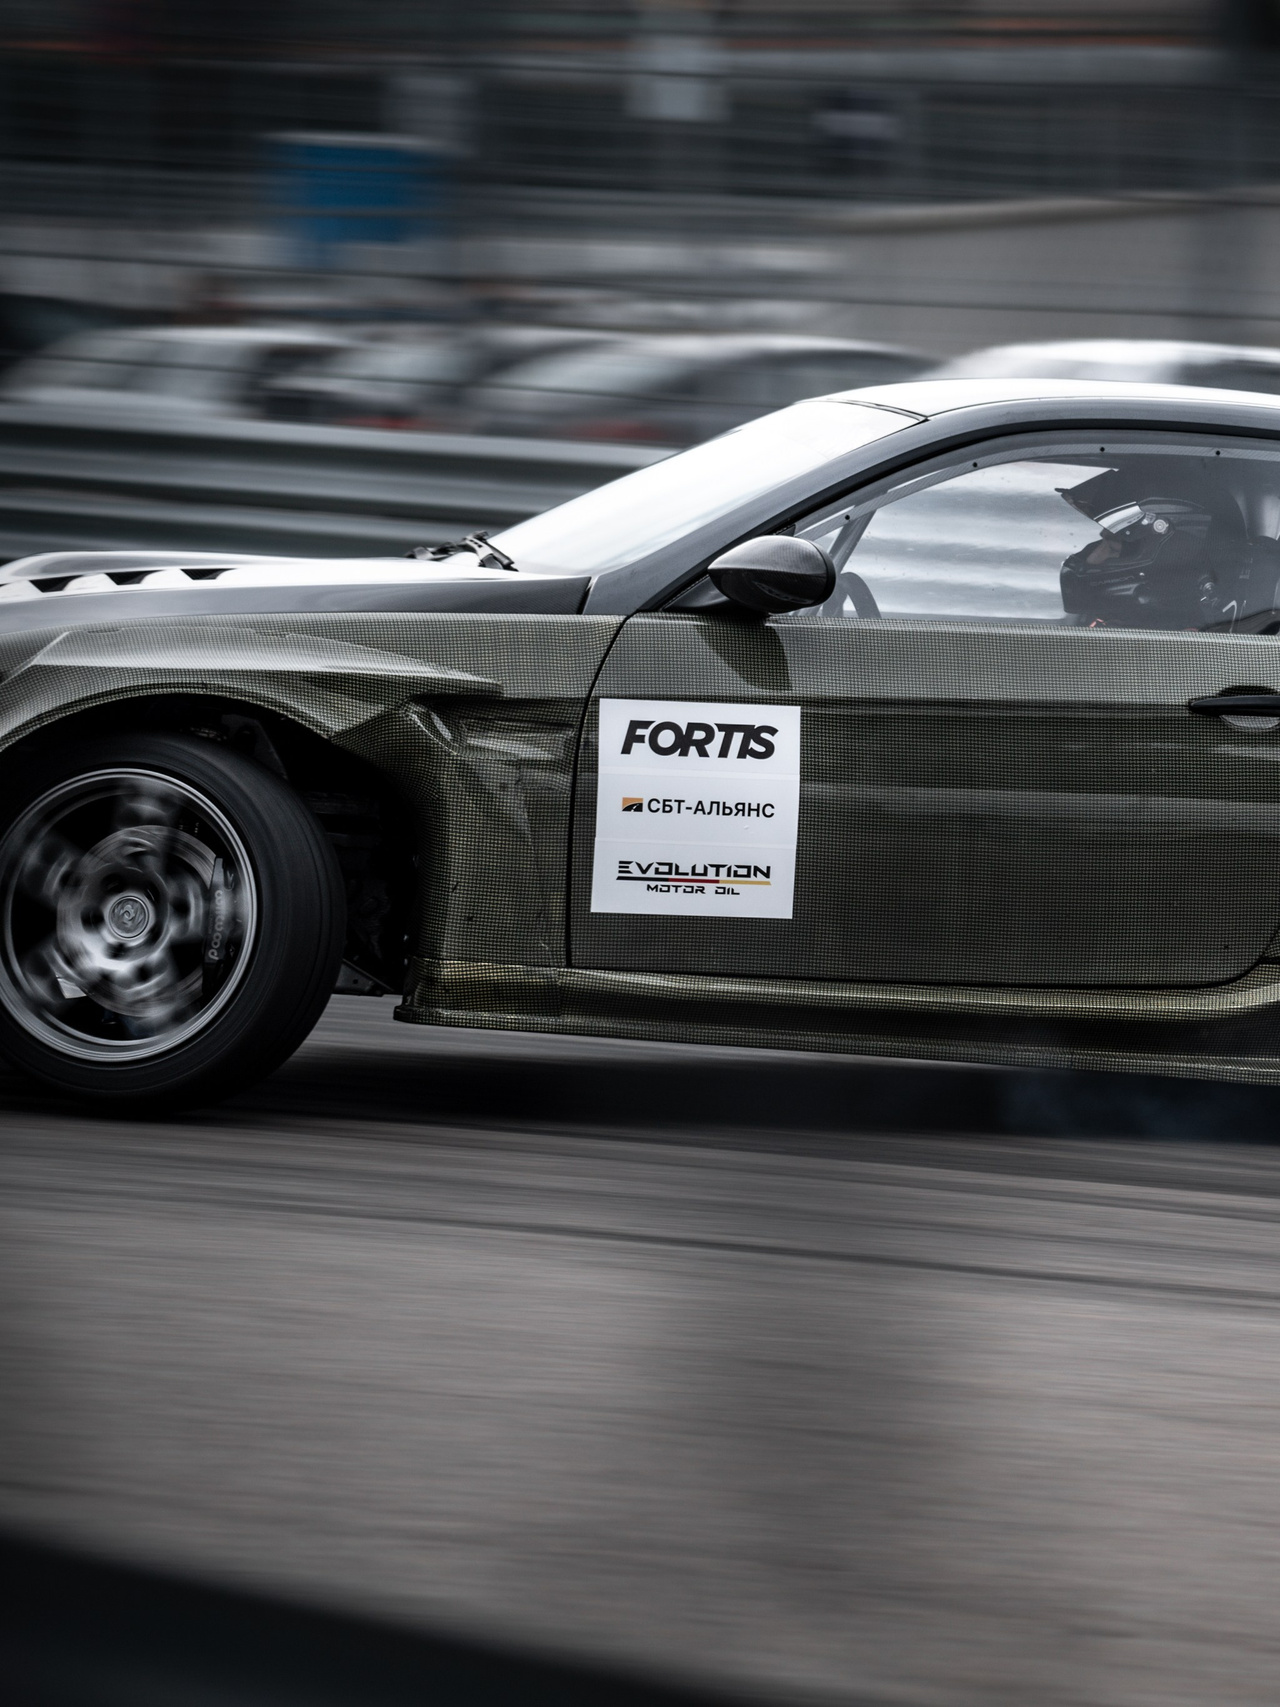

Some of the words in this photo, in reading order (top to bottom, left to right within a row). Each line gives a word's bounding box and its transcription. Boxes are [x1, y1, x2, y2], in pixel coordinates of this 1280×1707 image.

[620, 719, 780, 760] FORTIS
[647, 798, 775, 818] СБТ-АЛЬЯНС
[617, 860, 771, 879] EVOLUTION
[646, 884, 706, 894] MOTOR
[714, 886, 740, 895] OIL
